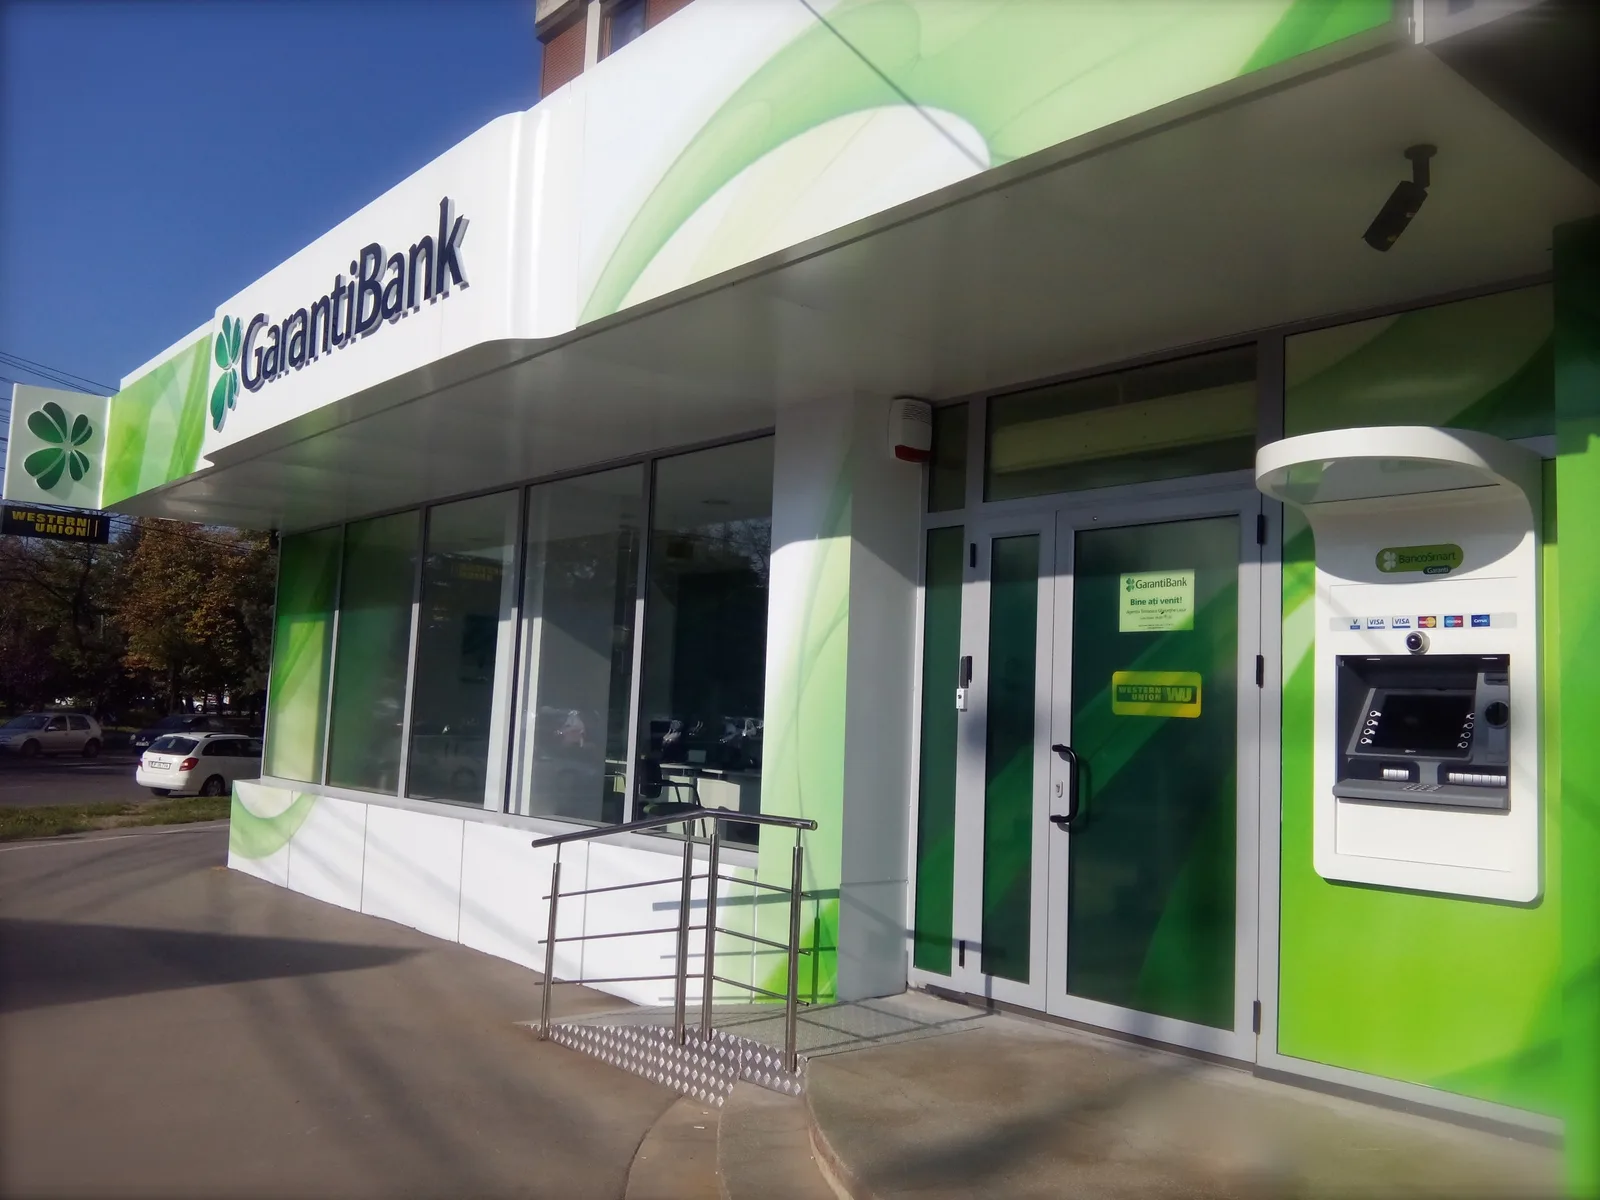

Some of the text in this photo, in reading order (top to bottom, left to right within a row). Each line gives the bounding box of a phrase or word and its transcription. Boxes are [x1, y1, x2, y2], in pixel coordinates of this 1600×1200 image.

[241, 196, 469, 393] GarantiBank
[12, 511, 87, 526] WESTERN
[35, 523, 87, 537] UNION
[1399, 552, 1457, 564] BancoSmart
[1135, 577, 1187, 589] GarantiBank
[1160, 596, 1182, 605] venit!
[1394, 617, 1410, 625] VISA
[1119, 686, 1162, 694] WESTERN
[1131, 693, 1162, 701] UNION
